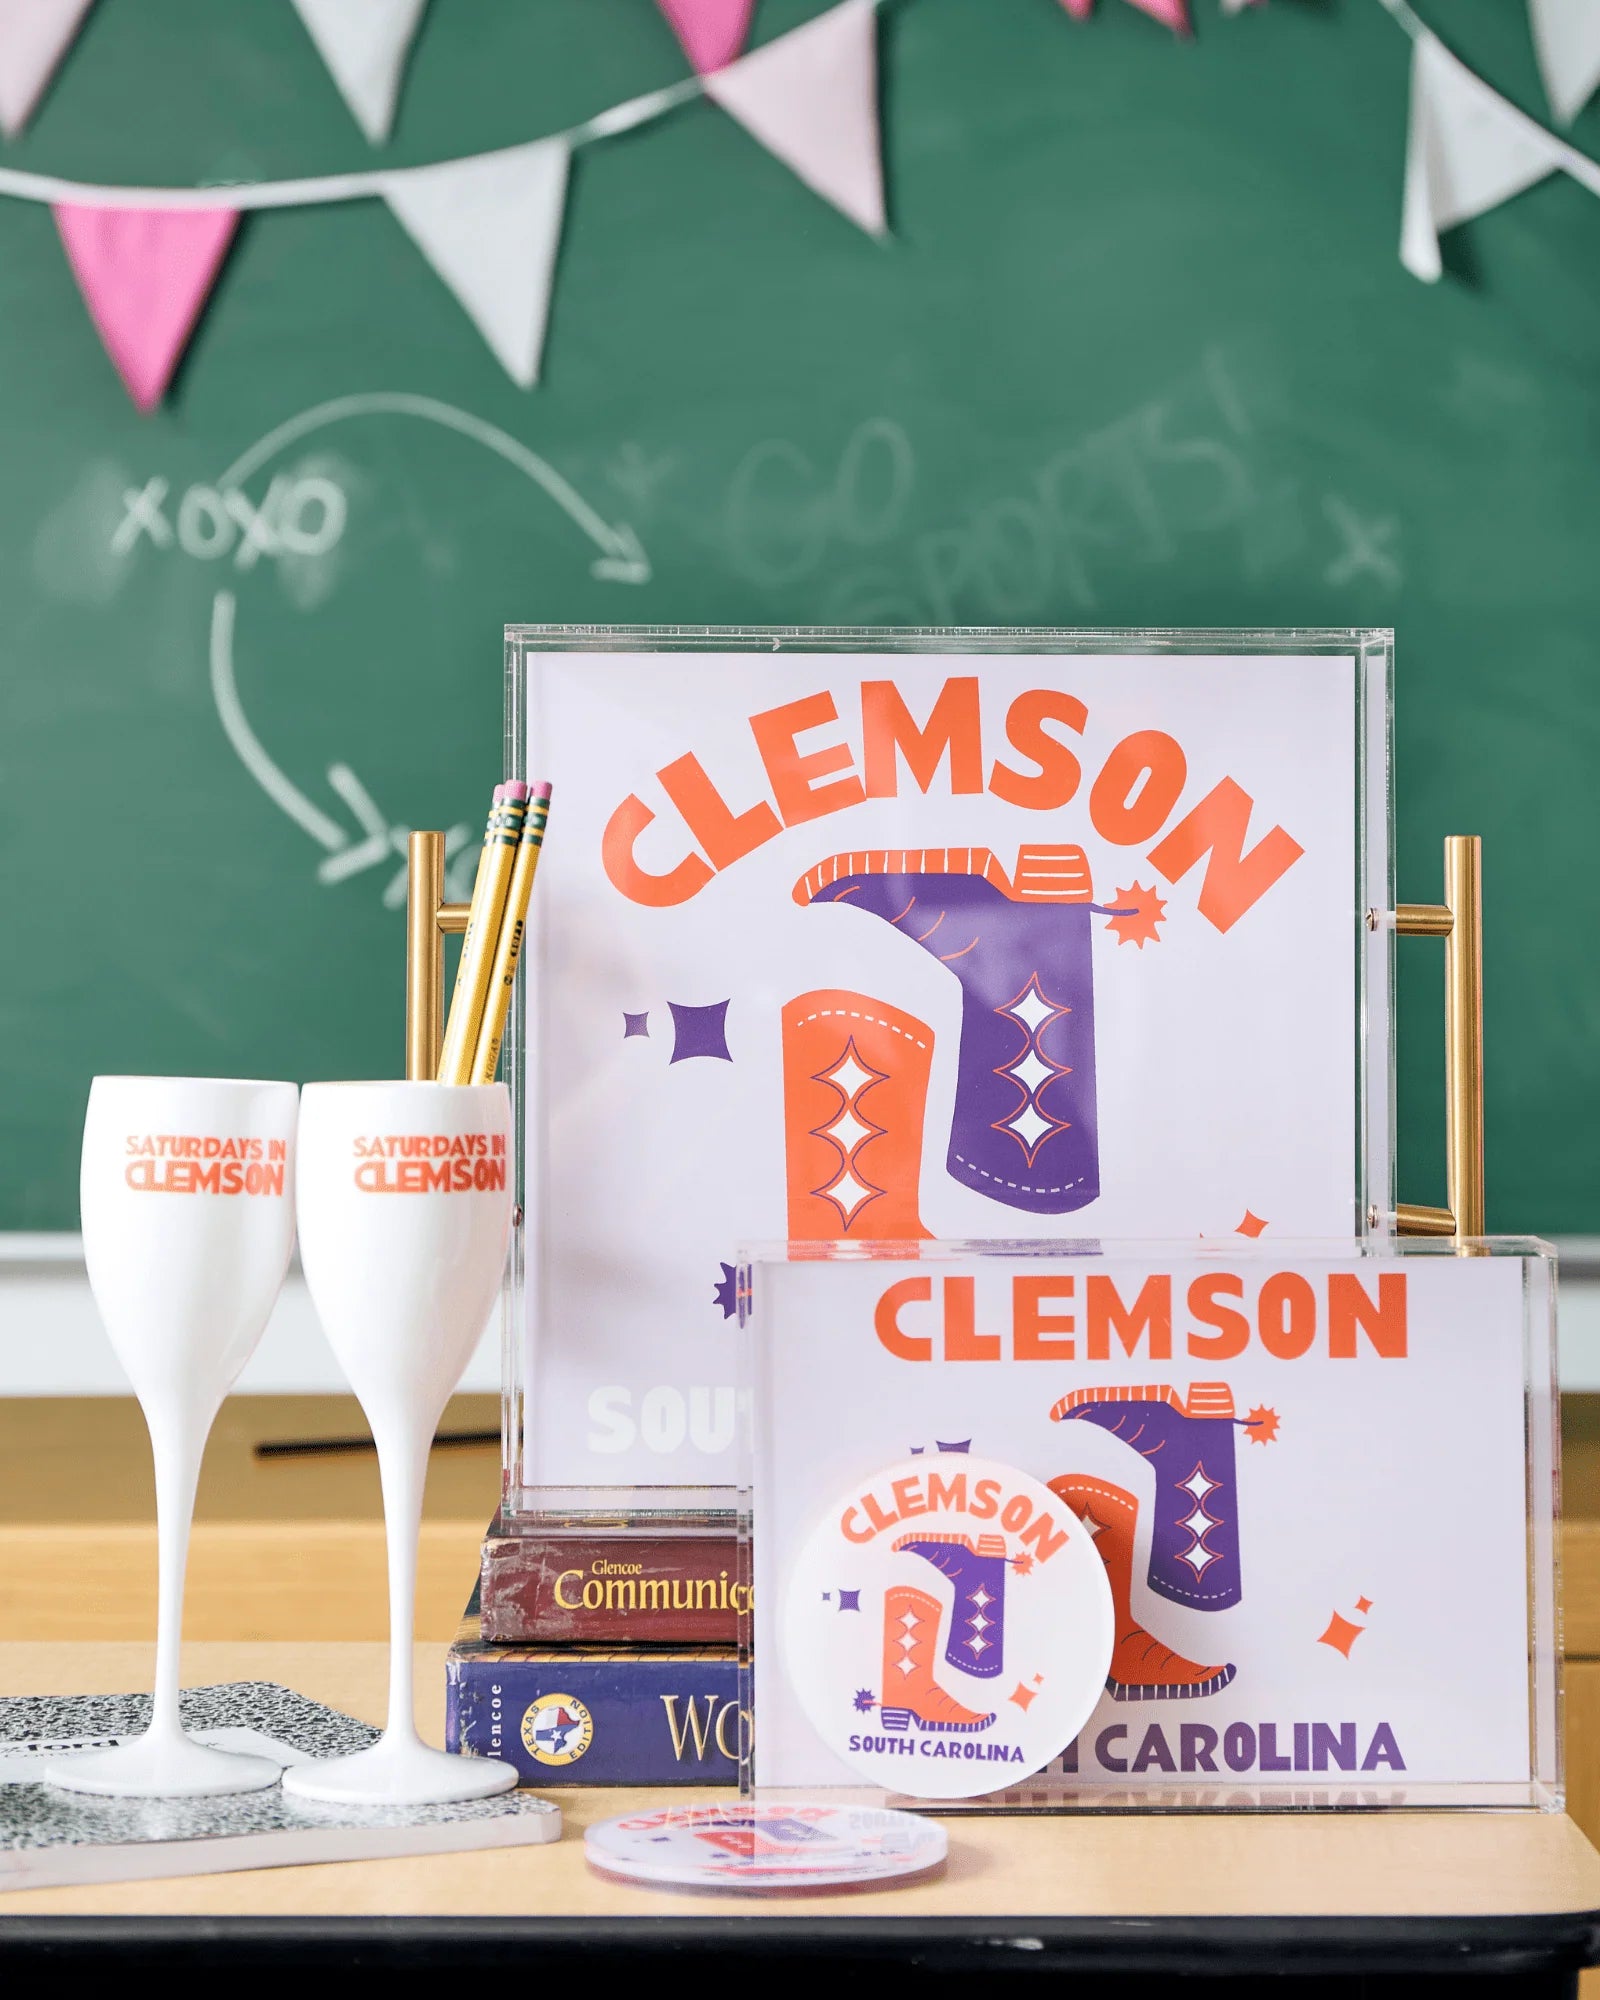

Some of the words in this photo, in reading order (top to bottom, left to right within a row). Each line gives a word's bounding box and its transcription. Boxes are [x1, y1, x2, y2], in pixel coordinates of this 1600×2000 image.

[602, 676, 1305, 934] CLEMSON
[126, 1135, 264, 1160] SATURDAYS
[268, 1139, 286, 1161] IN
[353, 1134, 488, 1157] SATURDAYS
[491, 1133, 506, 1157] IN
[125, 1160, 284, 1196] CLEMSON
[353, 1158, 506, 1193] CLEMSON
[874, 1271, 1408, 1362] CLEMSON
[841, 1473, 1070, 1562] CLEMSON
[591, 1559, 642, 1575] Glencoe
[554, 1569, 755, 1615] Communic
[487, 1684, 502, 1758] lencoe
[523, 1705, 541, 1757] TEXAS
[569, 1699, 593, 1760] EDITION
[849, 1734, 915, 1756] SOUTH
[920, 1740, 1026, 1763] CAROLINA
[1095, 1722, 1408, 1773] CAROLINA
